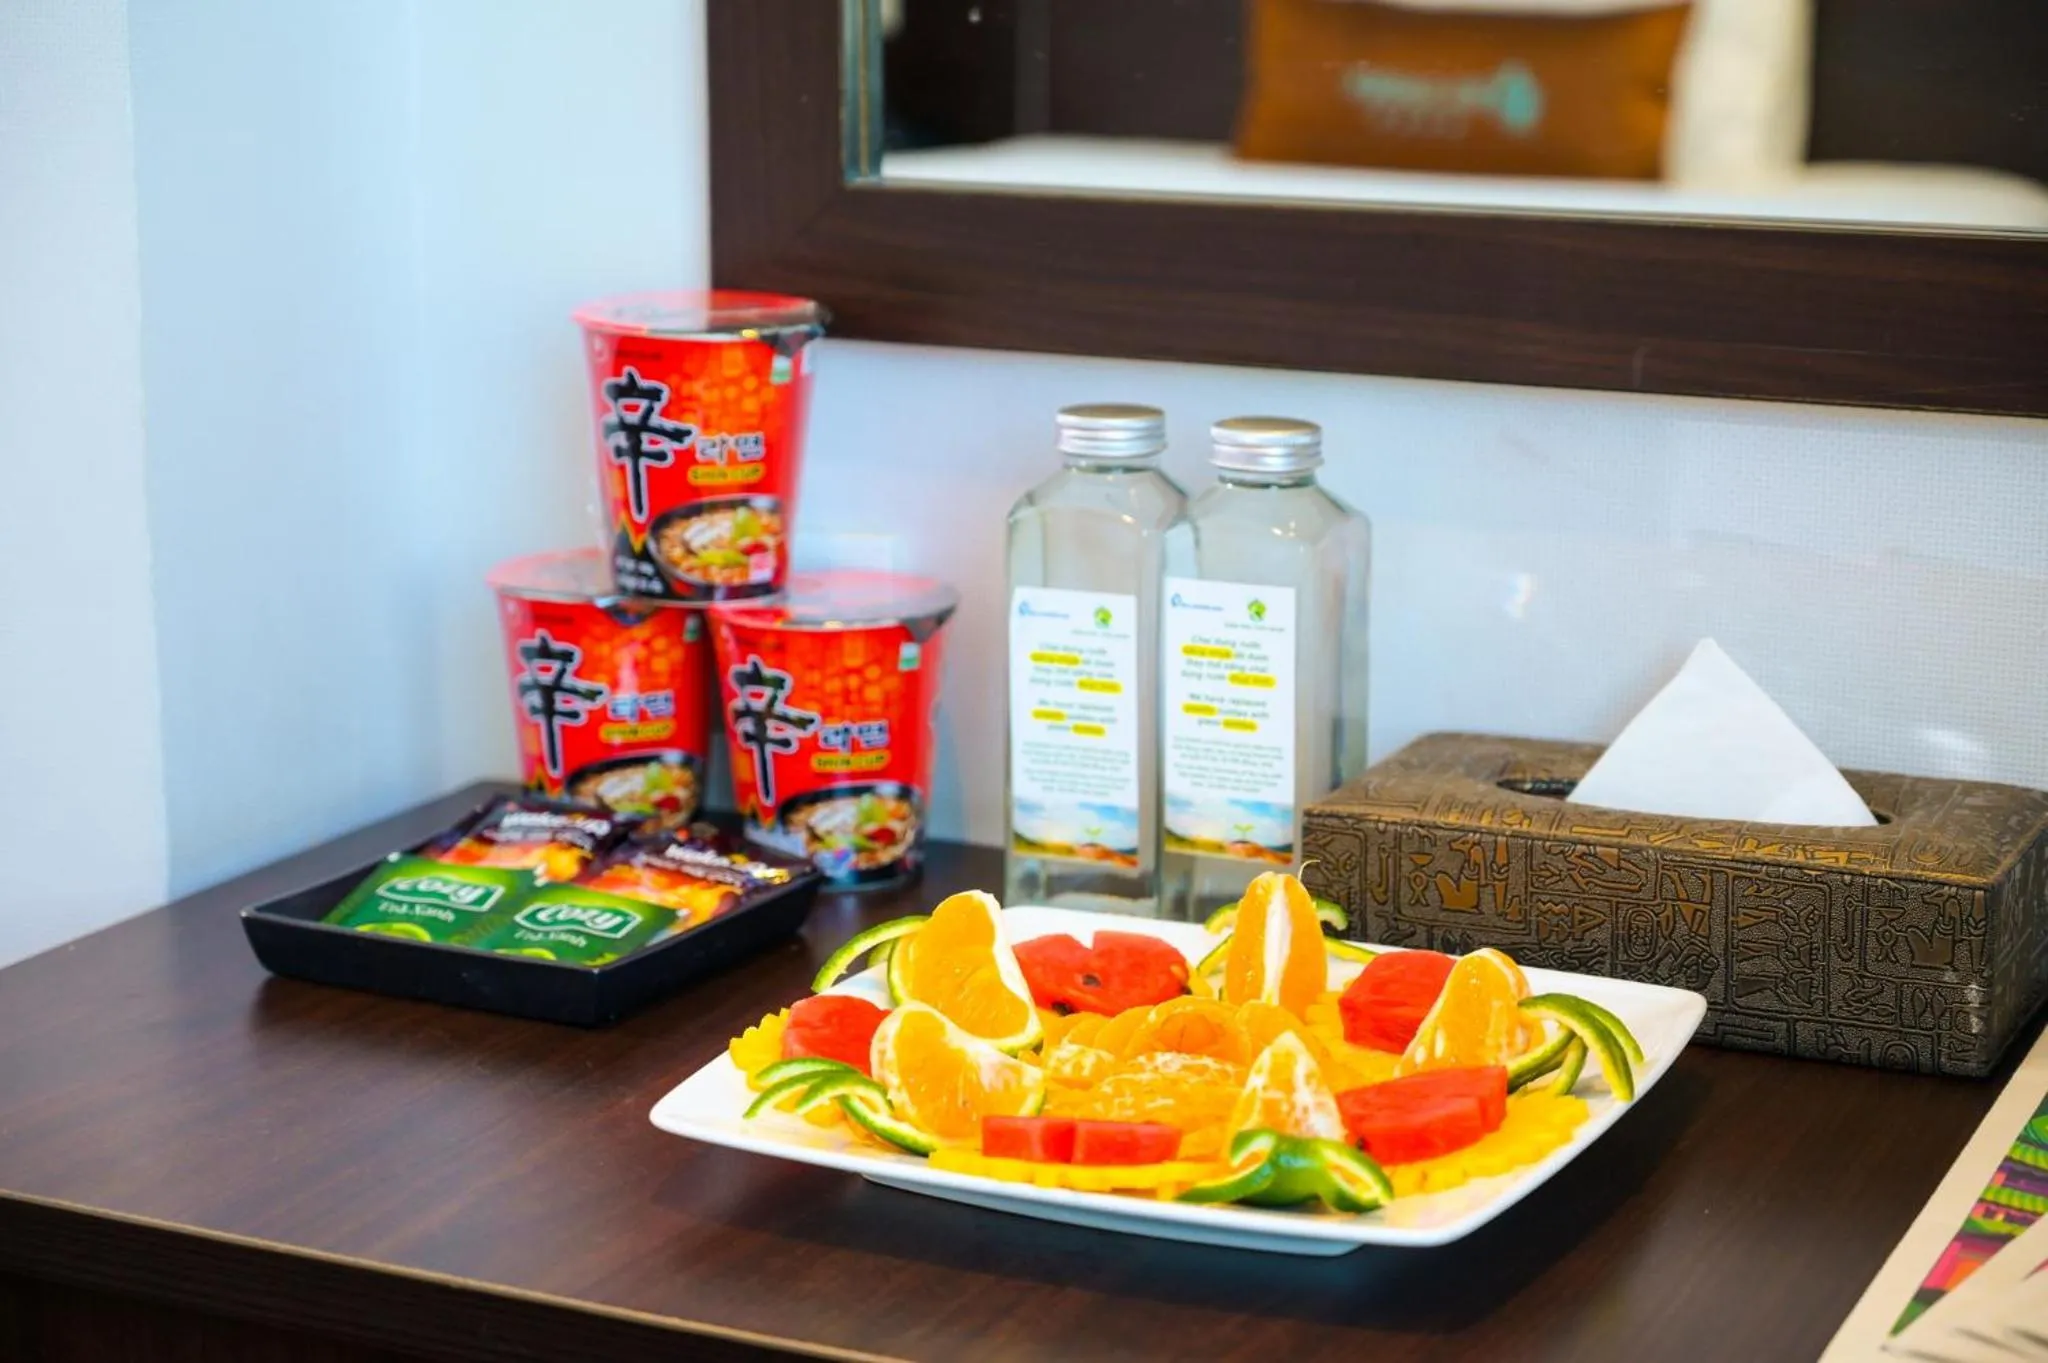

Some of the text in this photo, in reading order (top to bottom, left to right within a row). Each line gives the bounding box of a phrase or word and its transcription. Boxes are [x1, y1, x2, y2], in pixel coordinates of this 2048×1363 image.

[603, 368, 696, 520] 辛
[517, 631, 607, 775] 辛
[731, 657, 819, 804] 辛
[536, 904, 624, 930] Cozy
